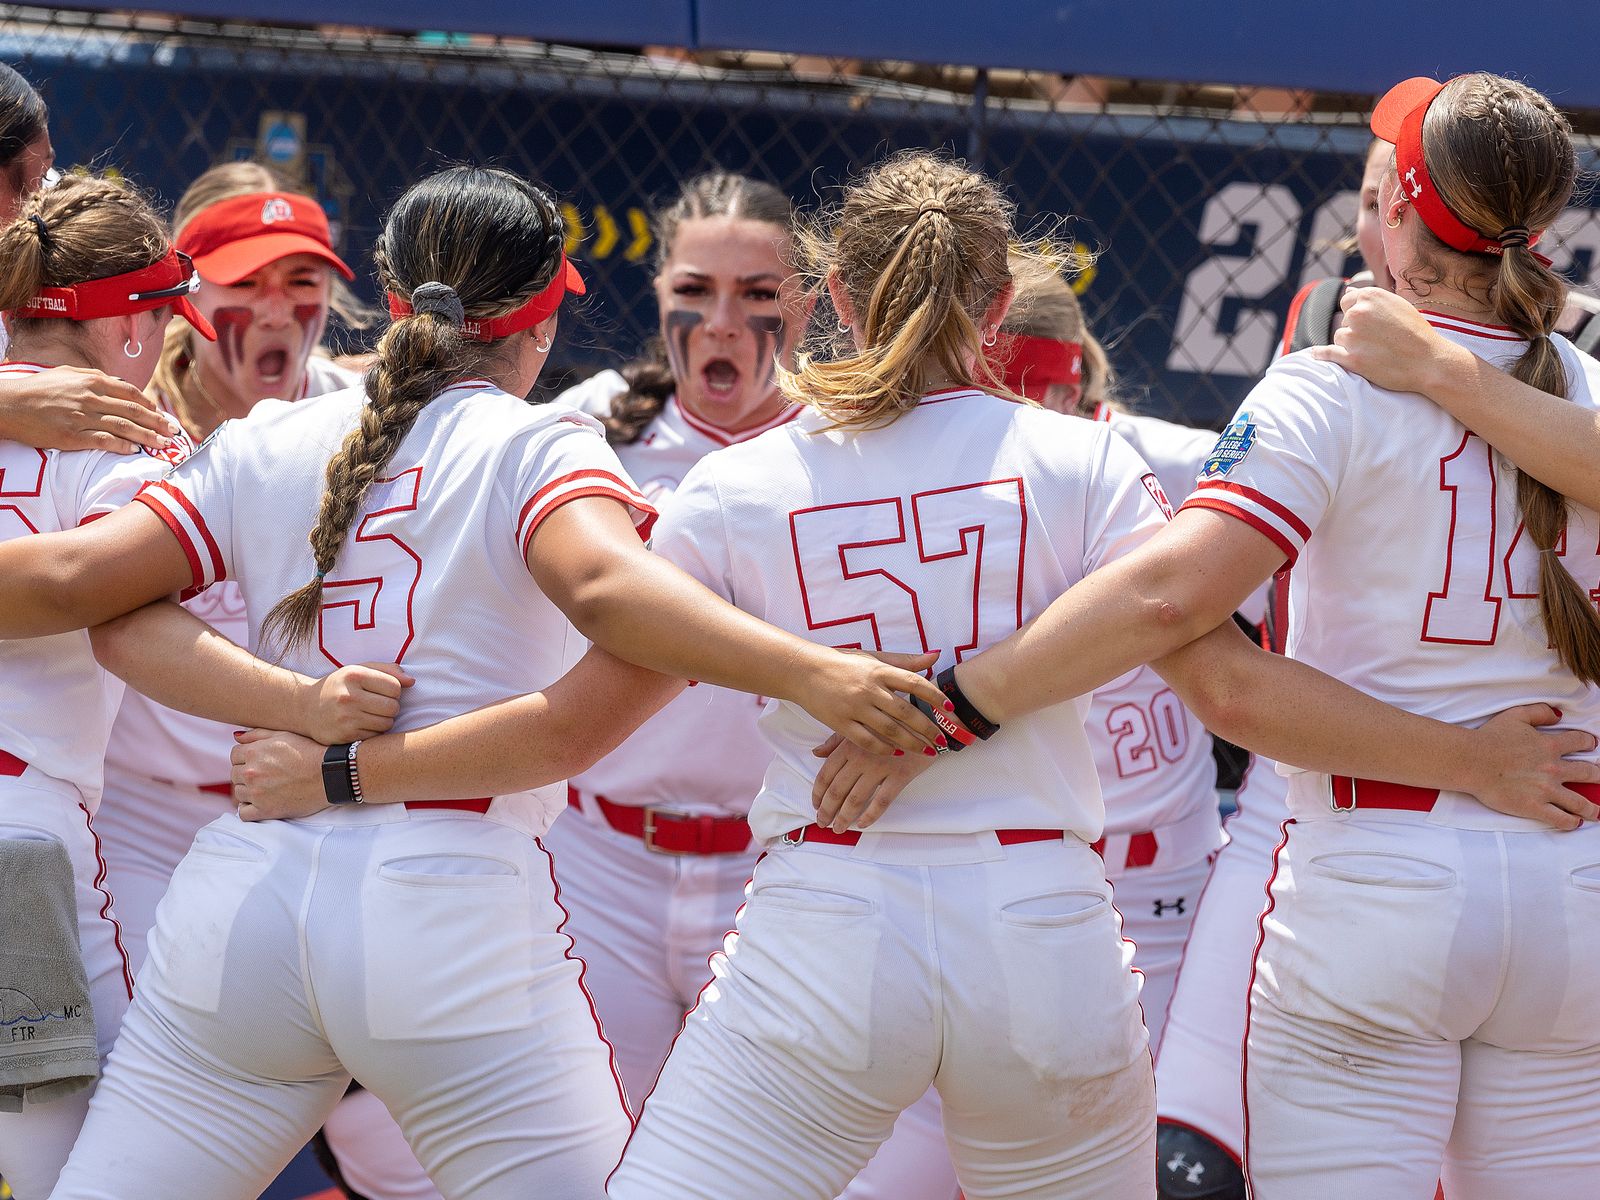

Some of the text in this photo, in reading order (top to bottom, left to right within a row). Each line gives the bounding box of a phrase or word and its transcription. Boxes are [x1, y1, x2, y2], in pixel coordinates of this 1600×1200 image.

[27, 297, 67, 311] SOFTBALL
[1221, 450, 1246, 459] SERIES
[318, 467, 423, 667] 5
[789, 477, 1028, 680] 57
[1106, 686, 1189, 778] 20
[63, 1004, 82, 1020] MC
[11, 1026, 36, 1041] FTR
